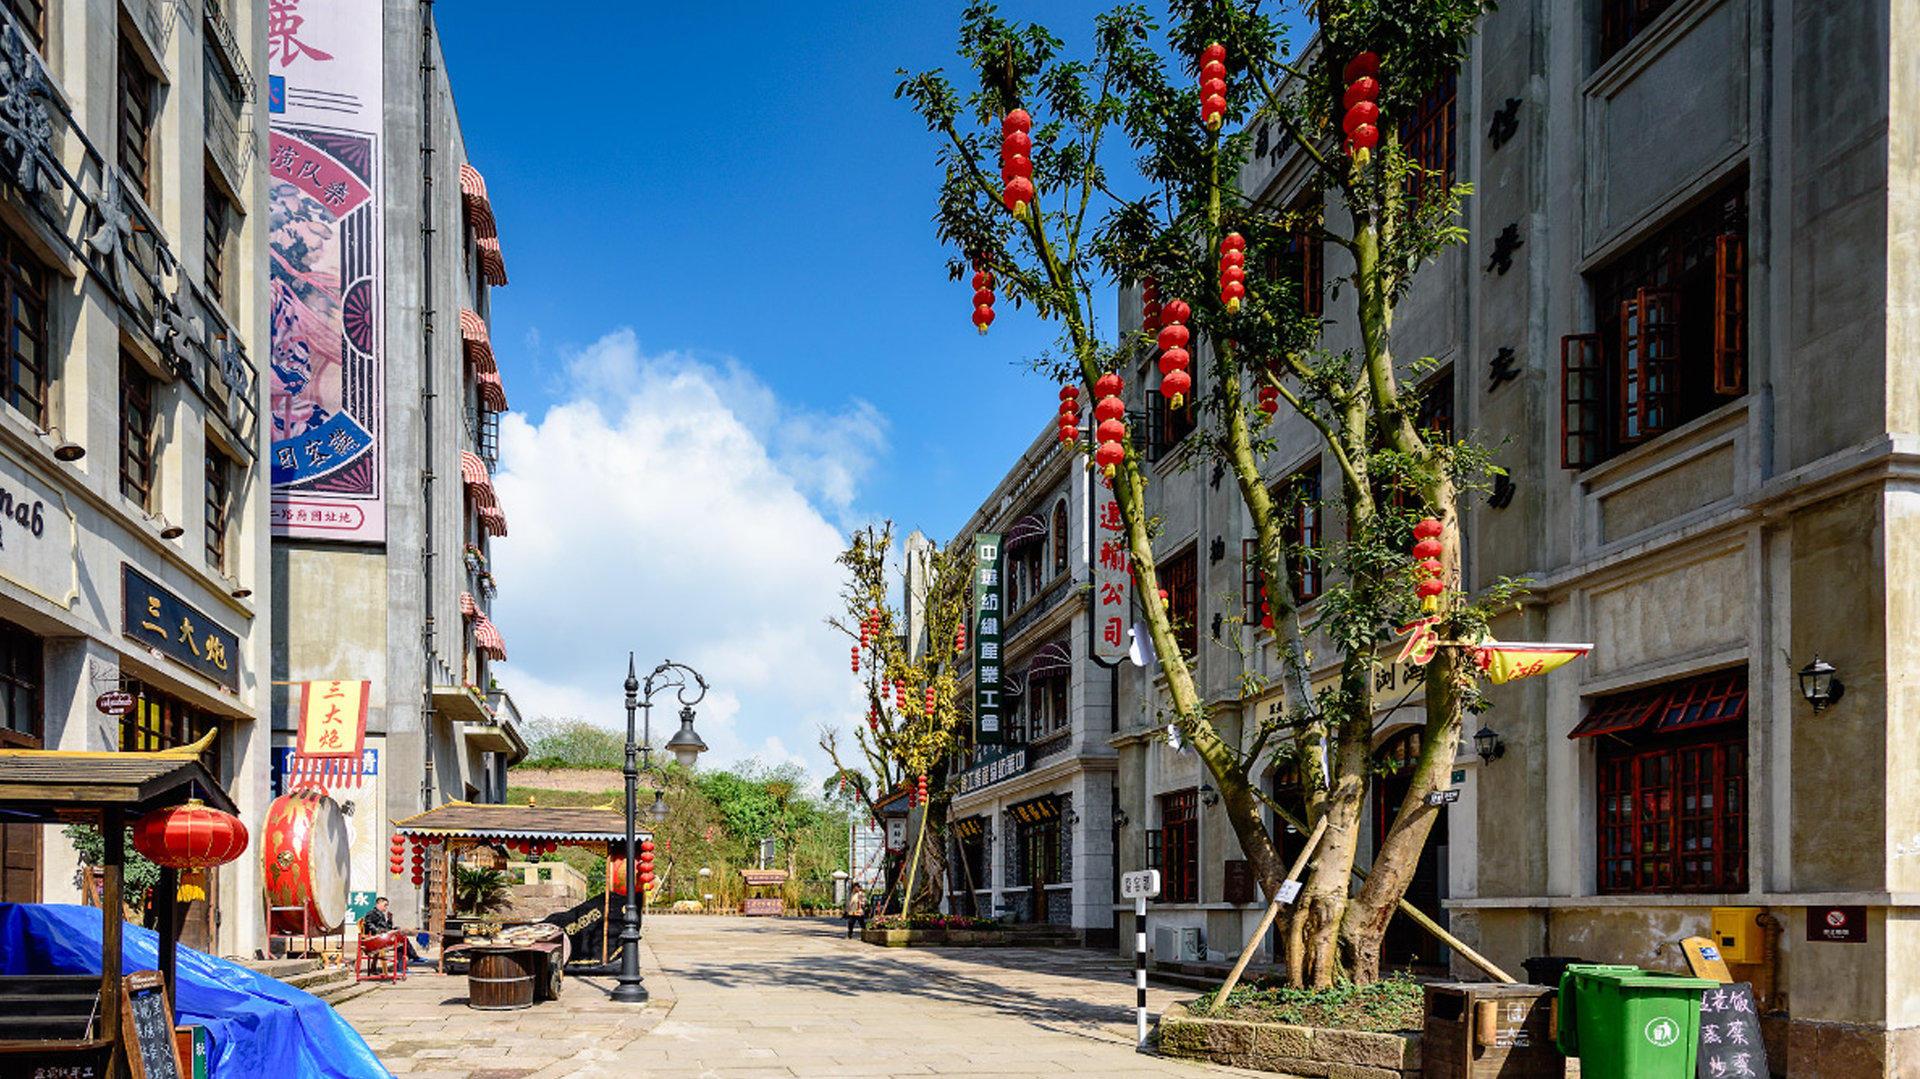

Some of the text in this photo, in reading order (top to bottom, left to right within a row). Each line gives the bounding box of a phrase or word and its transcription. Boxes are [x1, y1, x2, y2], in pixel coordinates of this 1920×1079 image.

[1100, 469, 1127, 647] 運輸公司
[141, 596, 228, 670] 三大炮
[318, 681, 345, 749] 三大炮
